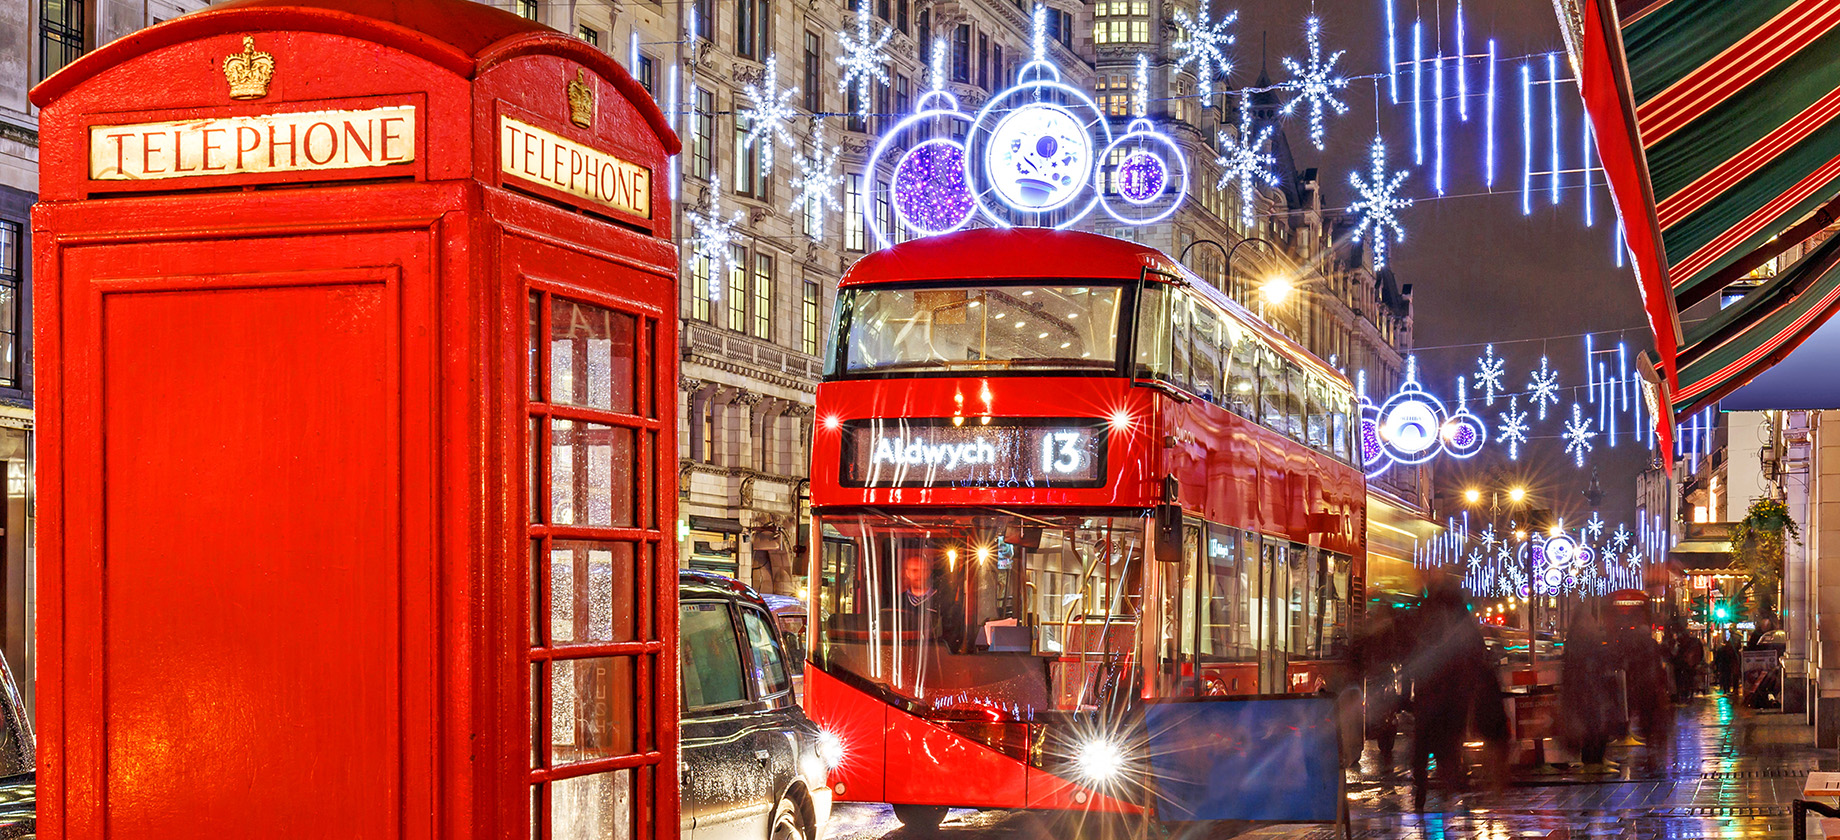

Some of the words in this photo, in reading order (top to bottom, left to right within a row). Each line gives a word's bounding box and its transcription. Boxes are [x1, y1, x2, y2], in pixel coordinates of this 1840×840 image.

[106, 117, 405, 174] TELEPHONE
[506, 125, 643, 212] TELEPHONE
[873, 437, 995, 470] Aldwych
[1042, 431, 1081, 473] 13
[595, 667, 607, 734] PUSH
